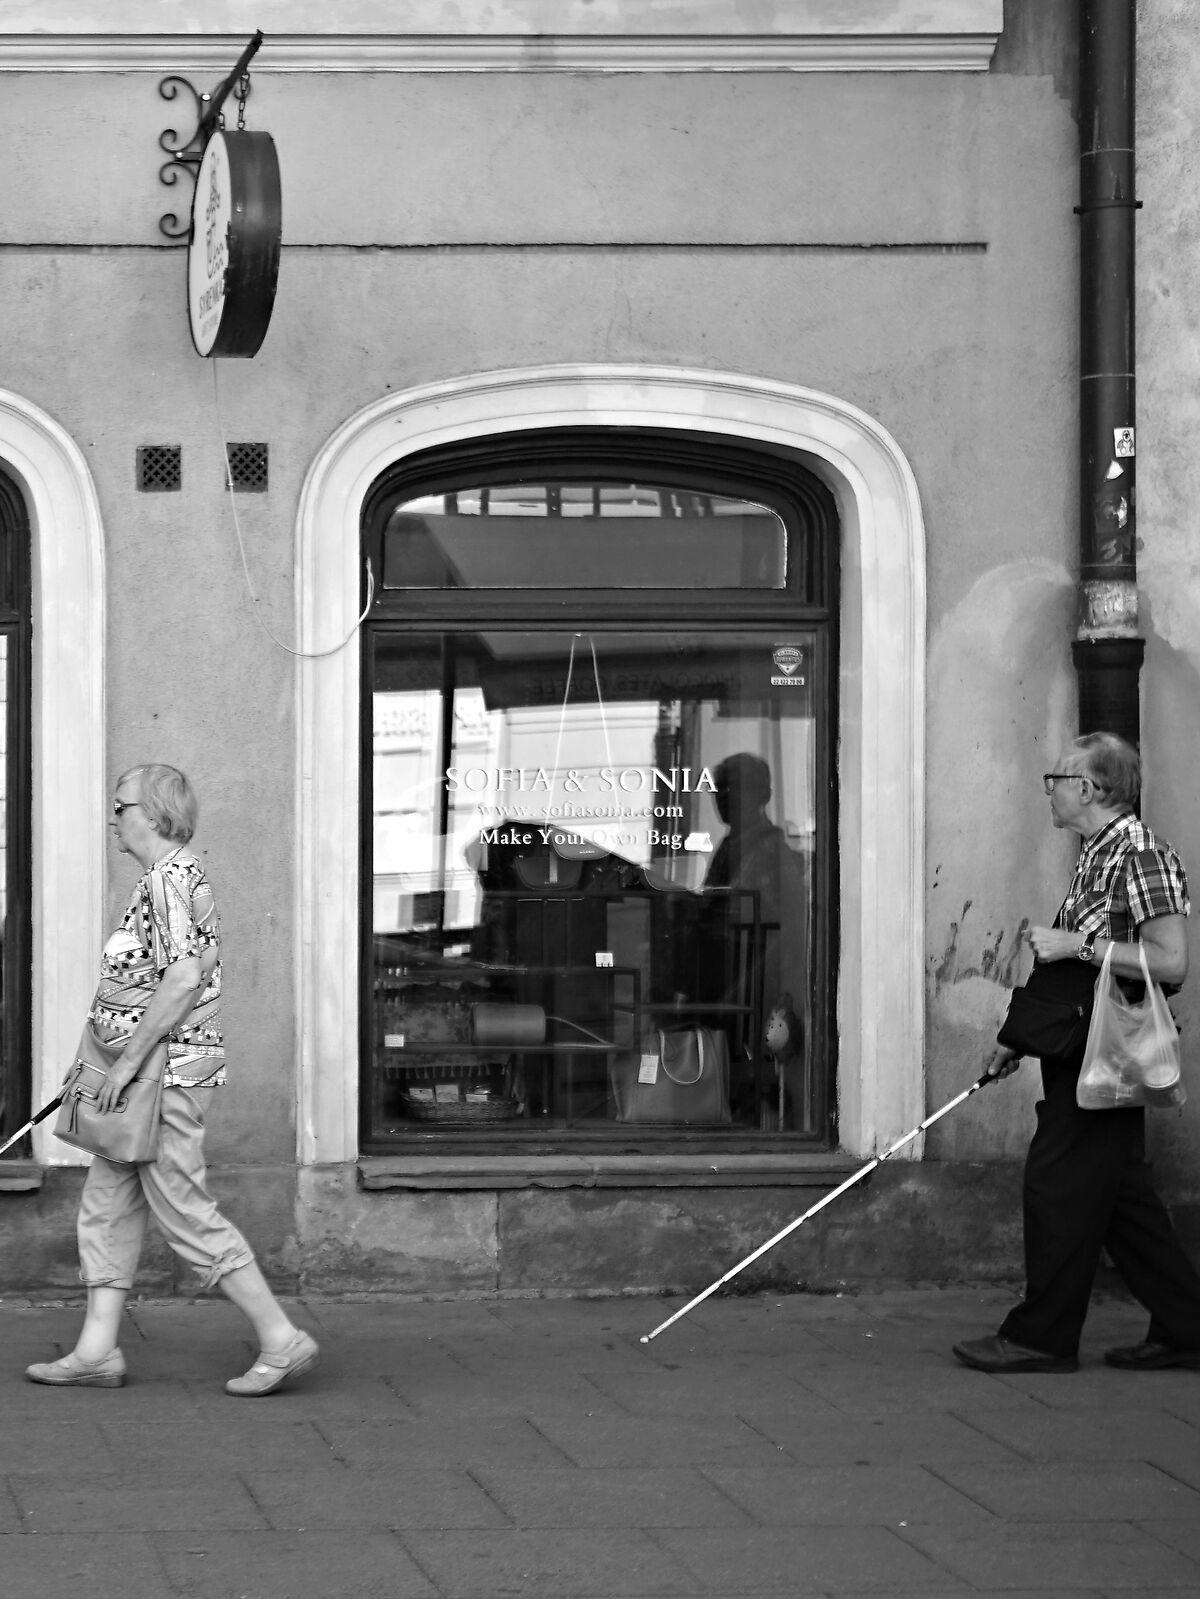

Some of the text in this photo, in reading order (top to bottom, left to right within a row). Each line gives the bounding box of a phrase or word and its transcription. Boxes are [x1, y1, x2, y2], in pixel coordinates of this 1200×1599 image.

[445, 767, 718, 792] SOFIA & SONIA
[480, 828, 682, 850] Make Your Own Bag
